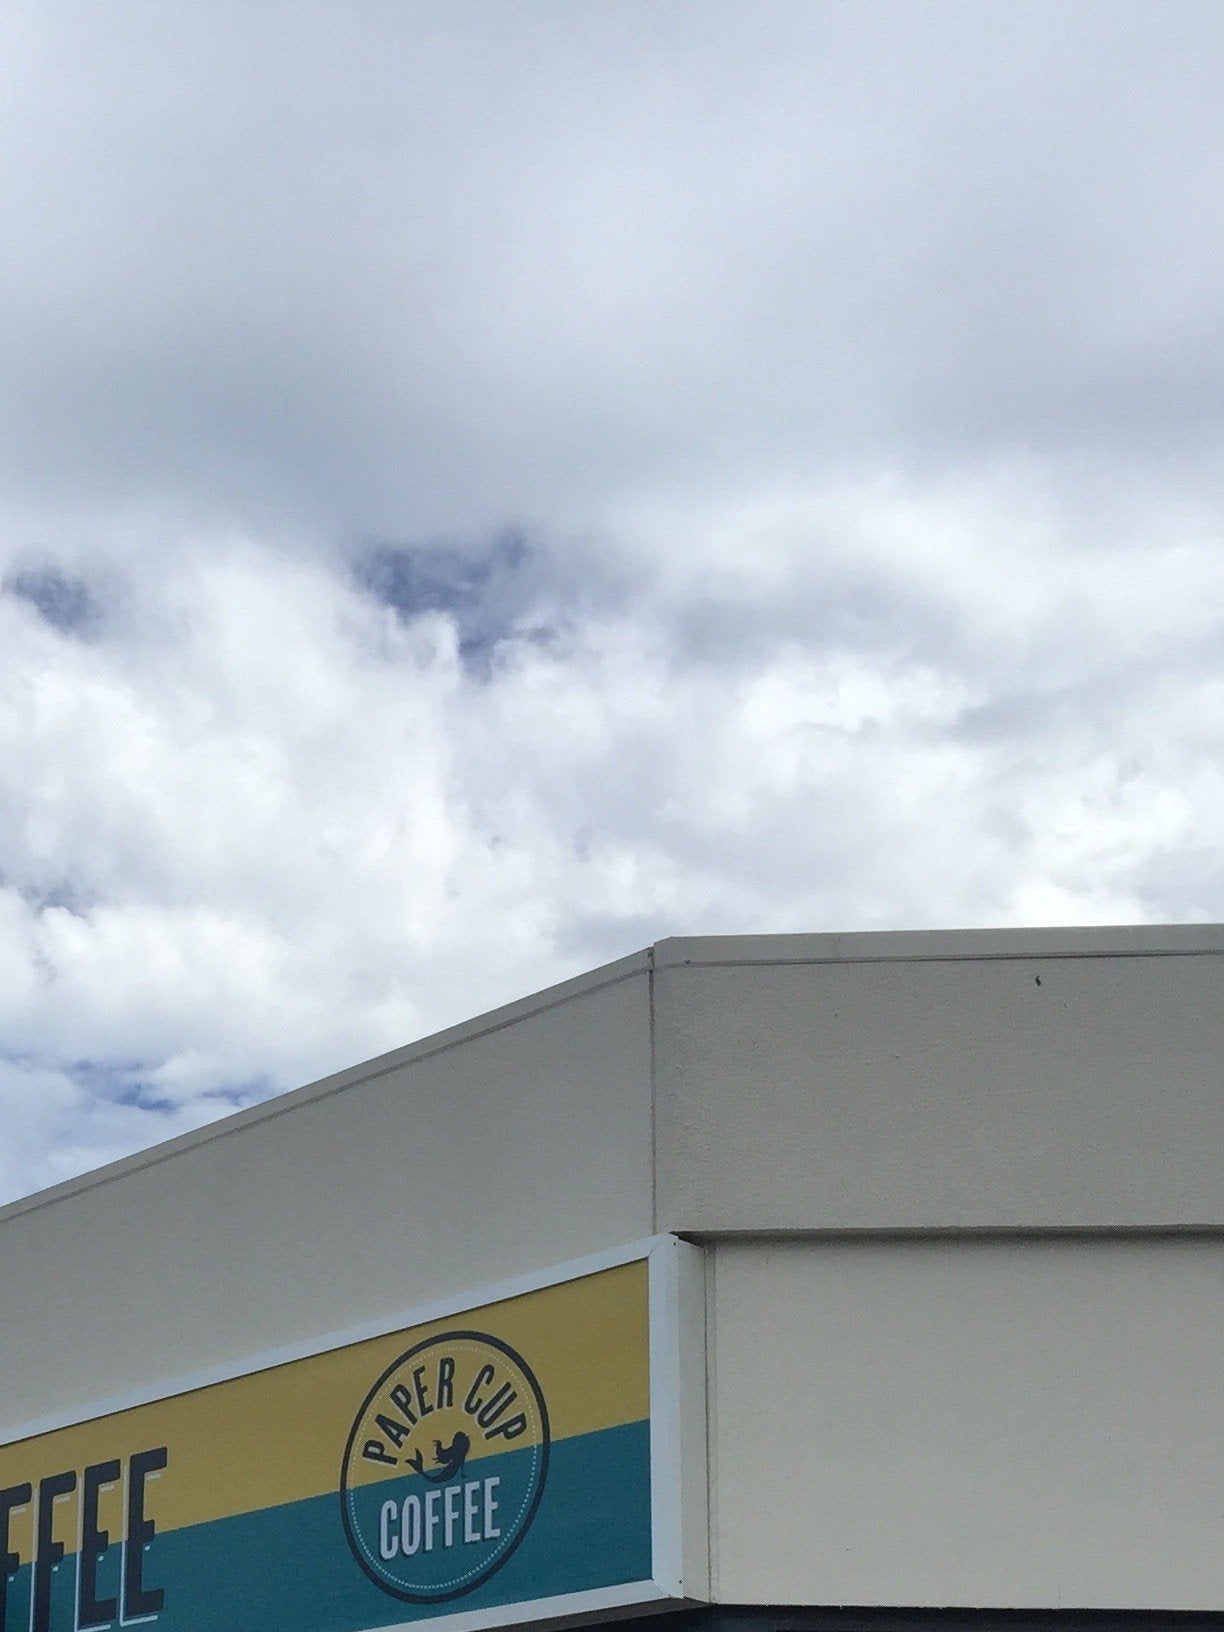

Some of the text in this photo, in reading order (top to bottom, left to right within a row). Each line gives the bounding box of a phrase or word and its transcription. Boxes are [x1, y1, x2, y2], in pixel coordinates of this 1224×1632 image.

[362, 1357, 527, 1467] PAPER CUP
[378, 1476, 501, 1561] COFFEE
